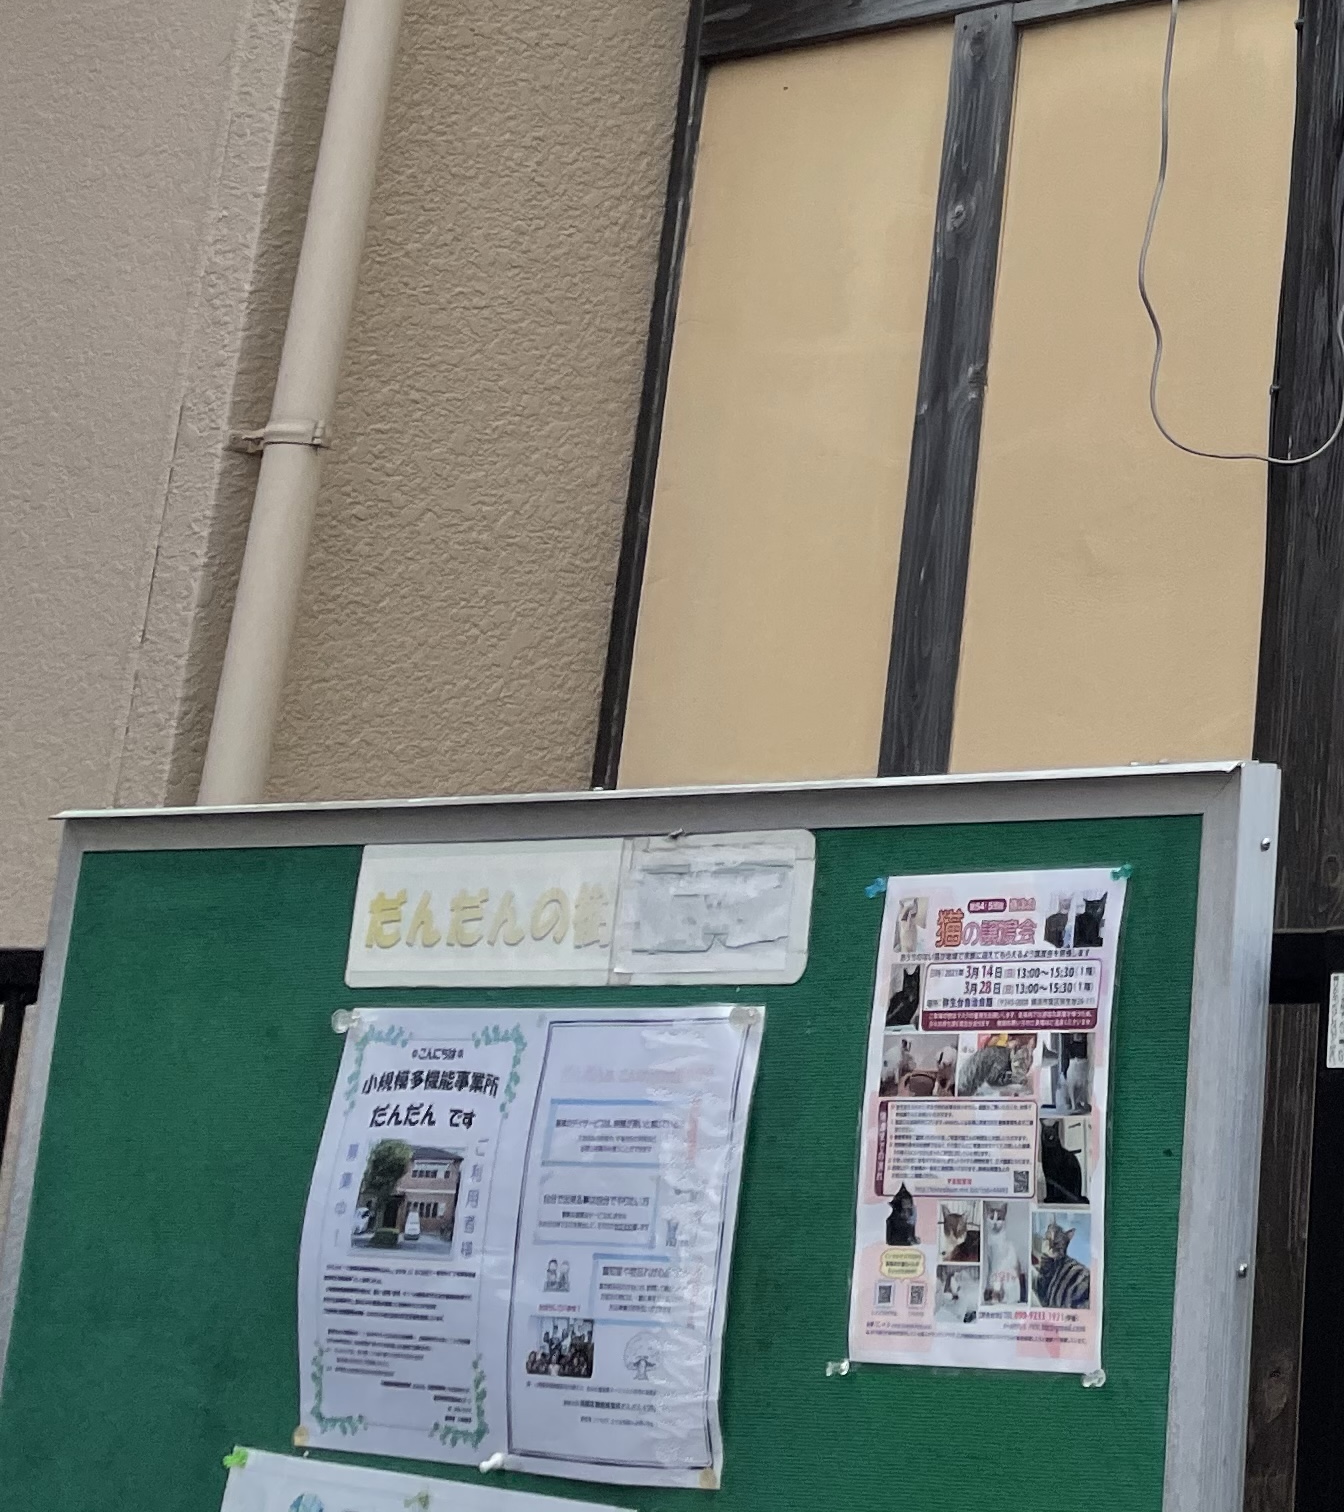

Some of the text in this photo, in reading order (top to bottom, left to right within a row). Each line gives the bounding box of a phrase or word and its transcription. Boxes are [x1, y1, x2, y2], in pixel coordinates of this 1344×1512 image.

[361, 1069, 500, 1099] 小規模多機能事業所
[369, 1102, 477, 1130] だんだん です
